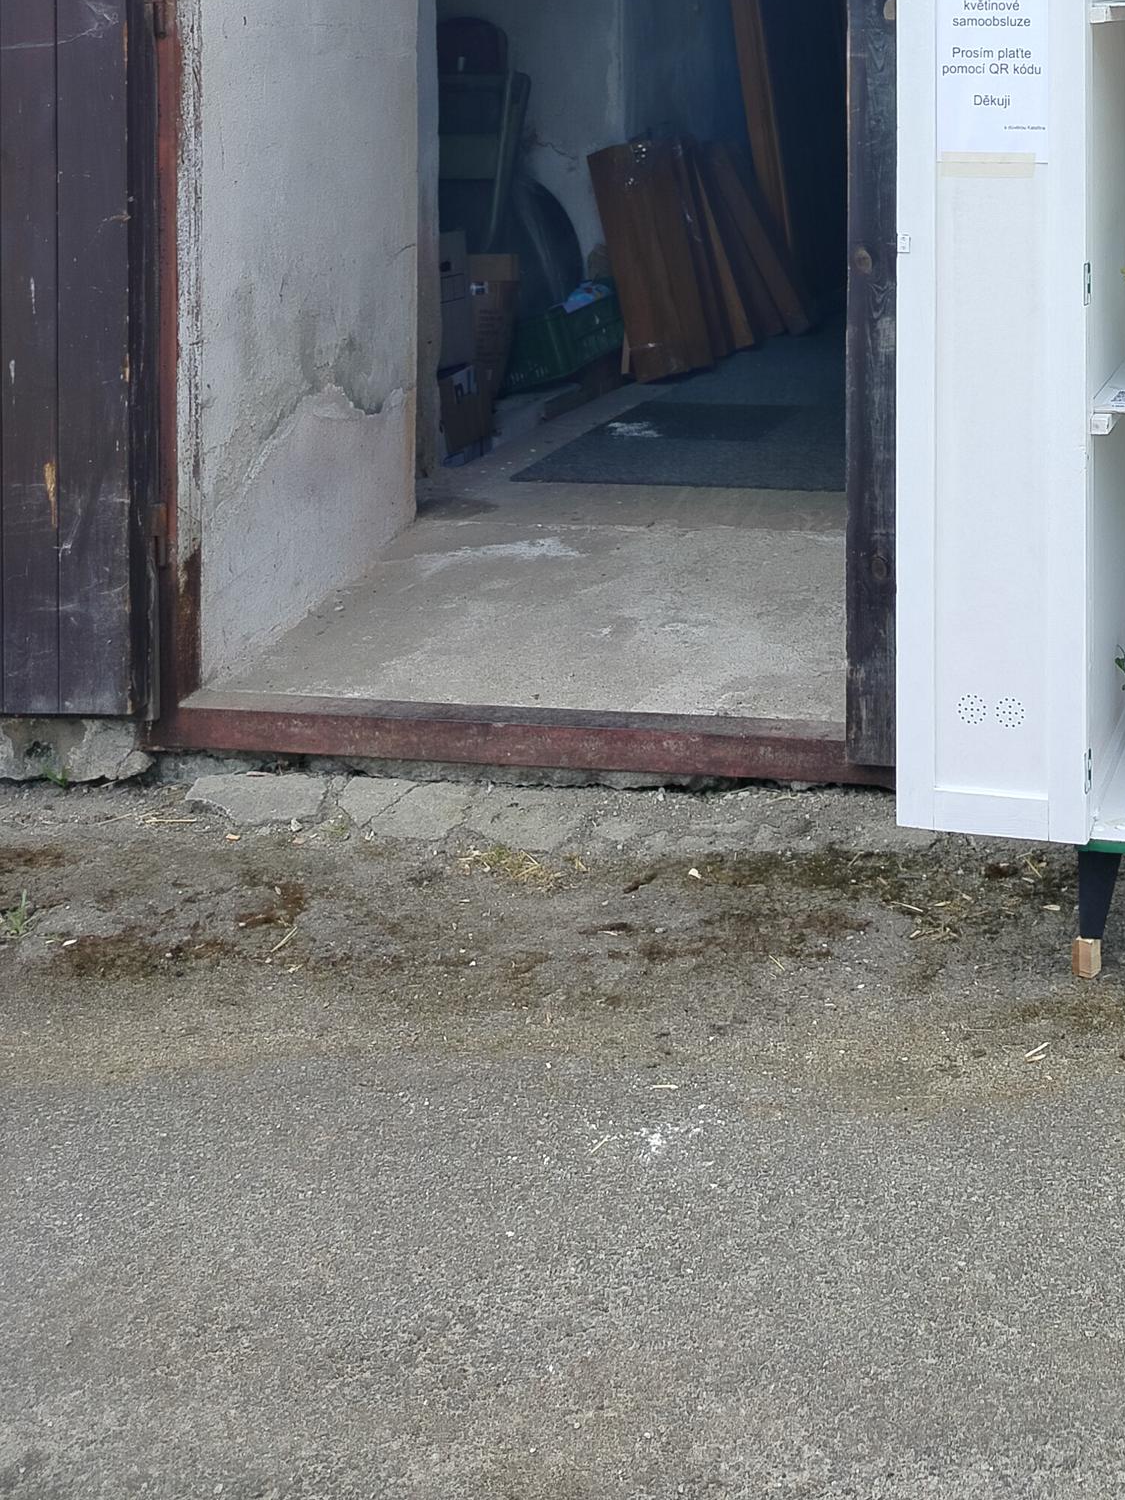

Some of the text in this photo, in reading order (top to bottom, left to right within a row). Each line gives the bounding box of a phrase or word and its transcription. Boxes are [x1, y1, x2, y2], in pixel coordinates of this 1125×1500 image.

[963, 0, 1020, 11] květinové
[952, 15, 1031, 27] samoobsluze
[952, 46, 1032, 61] Prosím plaťte
[942, 62, 1042, 77] pomocí QR kódu
[973, 94, 1011, 109] Děkuji
